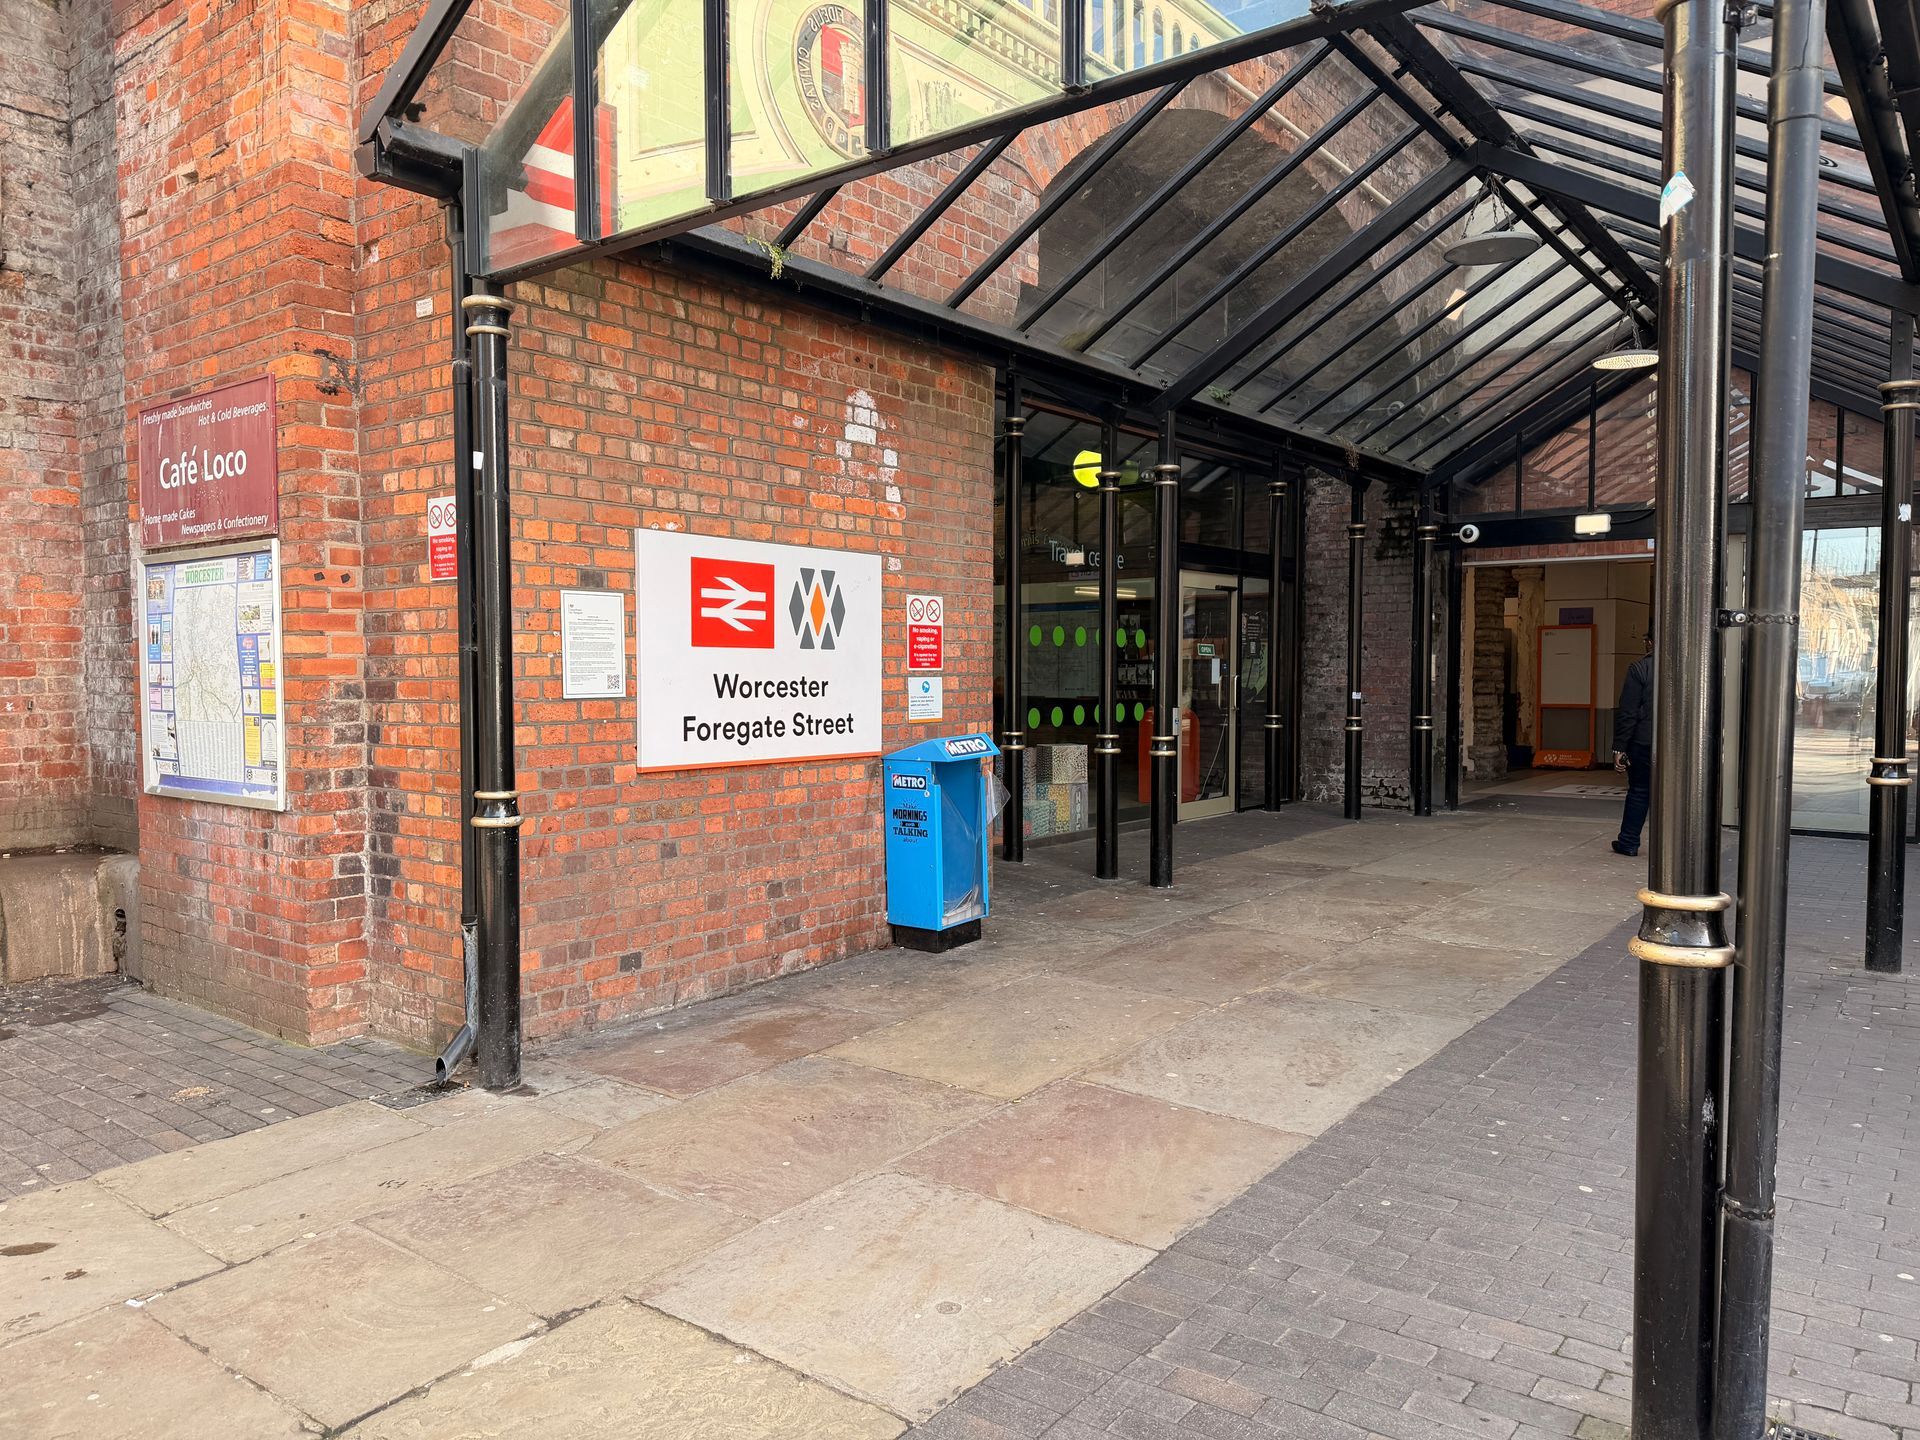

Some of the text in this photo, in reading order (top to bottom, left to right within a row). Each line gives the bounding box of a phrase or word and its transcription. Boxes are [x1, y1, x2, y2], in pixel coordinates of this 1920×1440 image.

[143, 399, 213, 426] Freshly made Sandwiches
[198, 414, 210, 426] Hot
[210, 412, 216, 423] &
[217, 408, 232, 422] Cold
[160, 445, 247, 489] Café Loco
[145, 508, 196, 525] Home made Cakes
[181, 514, 269, 535] Newspapers & Confectionery
[1088, 551, 1124, 569] cee
[185, 567, 225, 584] WORCESTER
[713, 673, 828, 699] Worcester
[683, 711, 854, 746] Foregate Street
[945, 738, 988, 755] METRO
[893, 774, 925, 788] METRO
[892, 808, 928, 821] MORNINGS
[893, 827, 928, 838] TALKING
